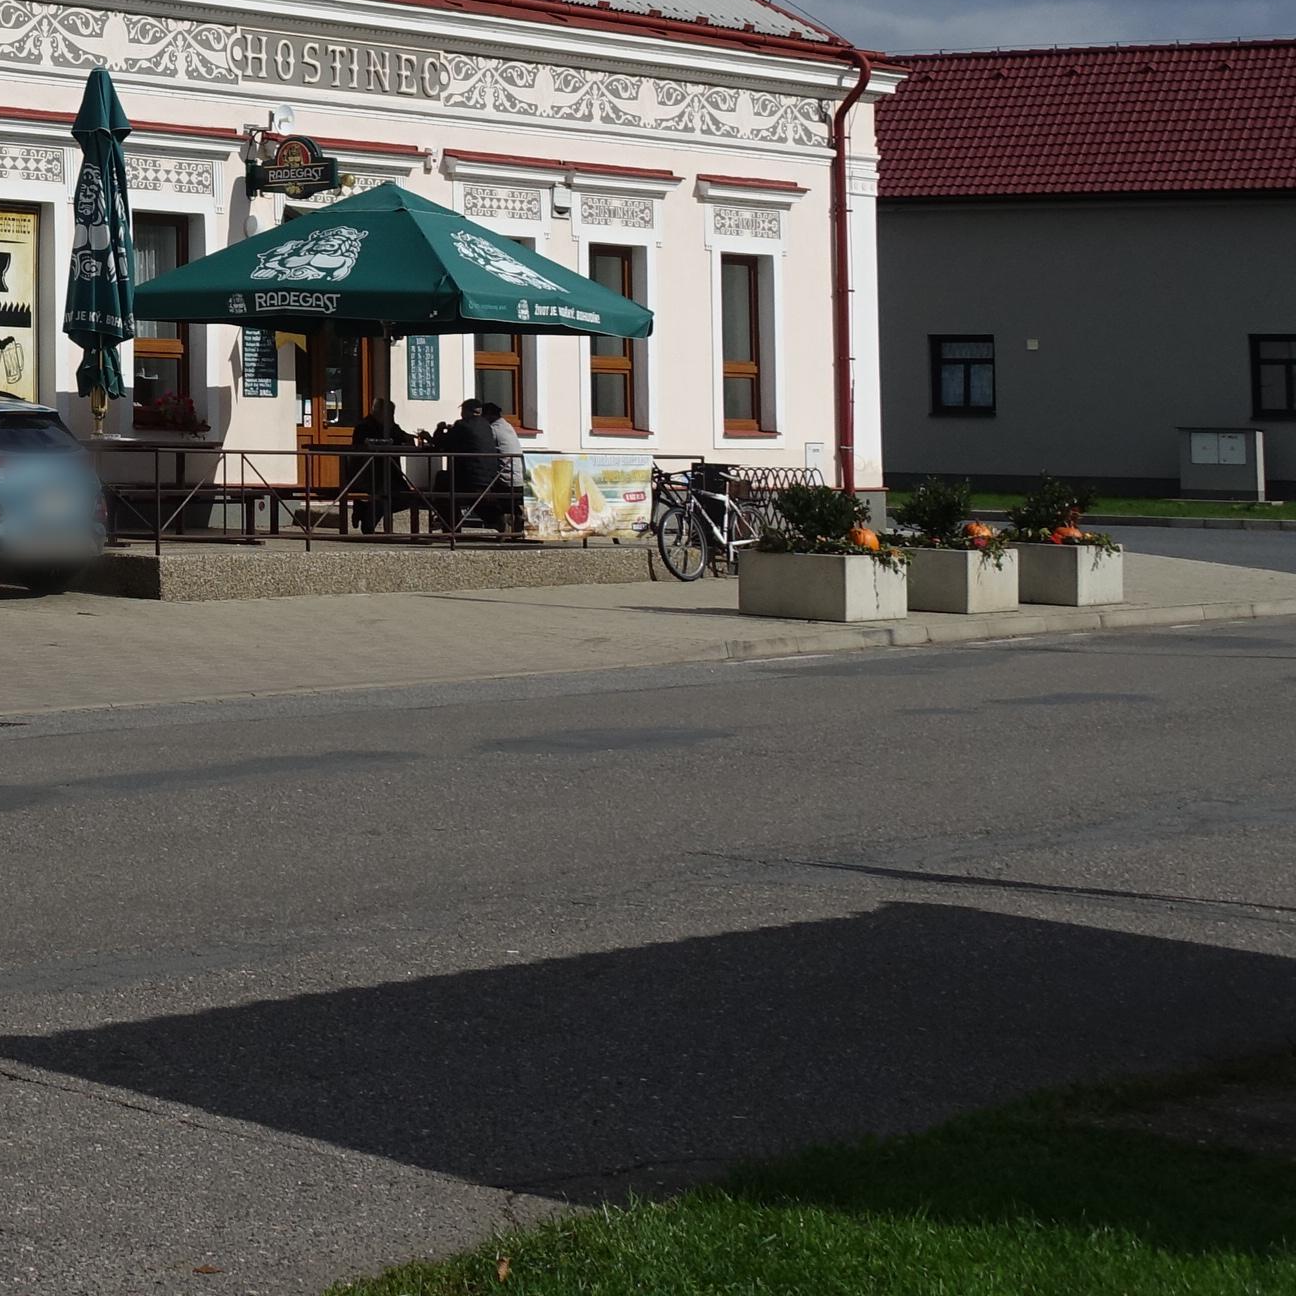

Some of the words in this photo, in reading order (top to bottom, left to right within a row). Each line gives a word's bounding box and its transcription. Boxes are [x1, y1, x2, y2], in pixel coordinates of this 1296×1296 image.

[242, 34, 440, 98] HOSTINEC
[269, 167, 325, 182] RADEGAST
[255, 291, 341, 314] RADEGAST
